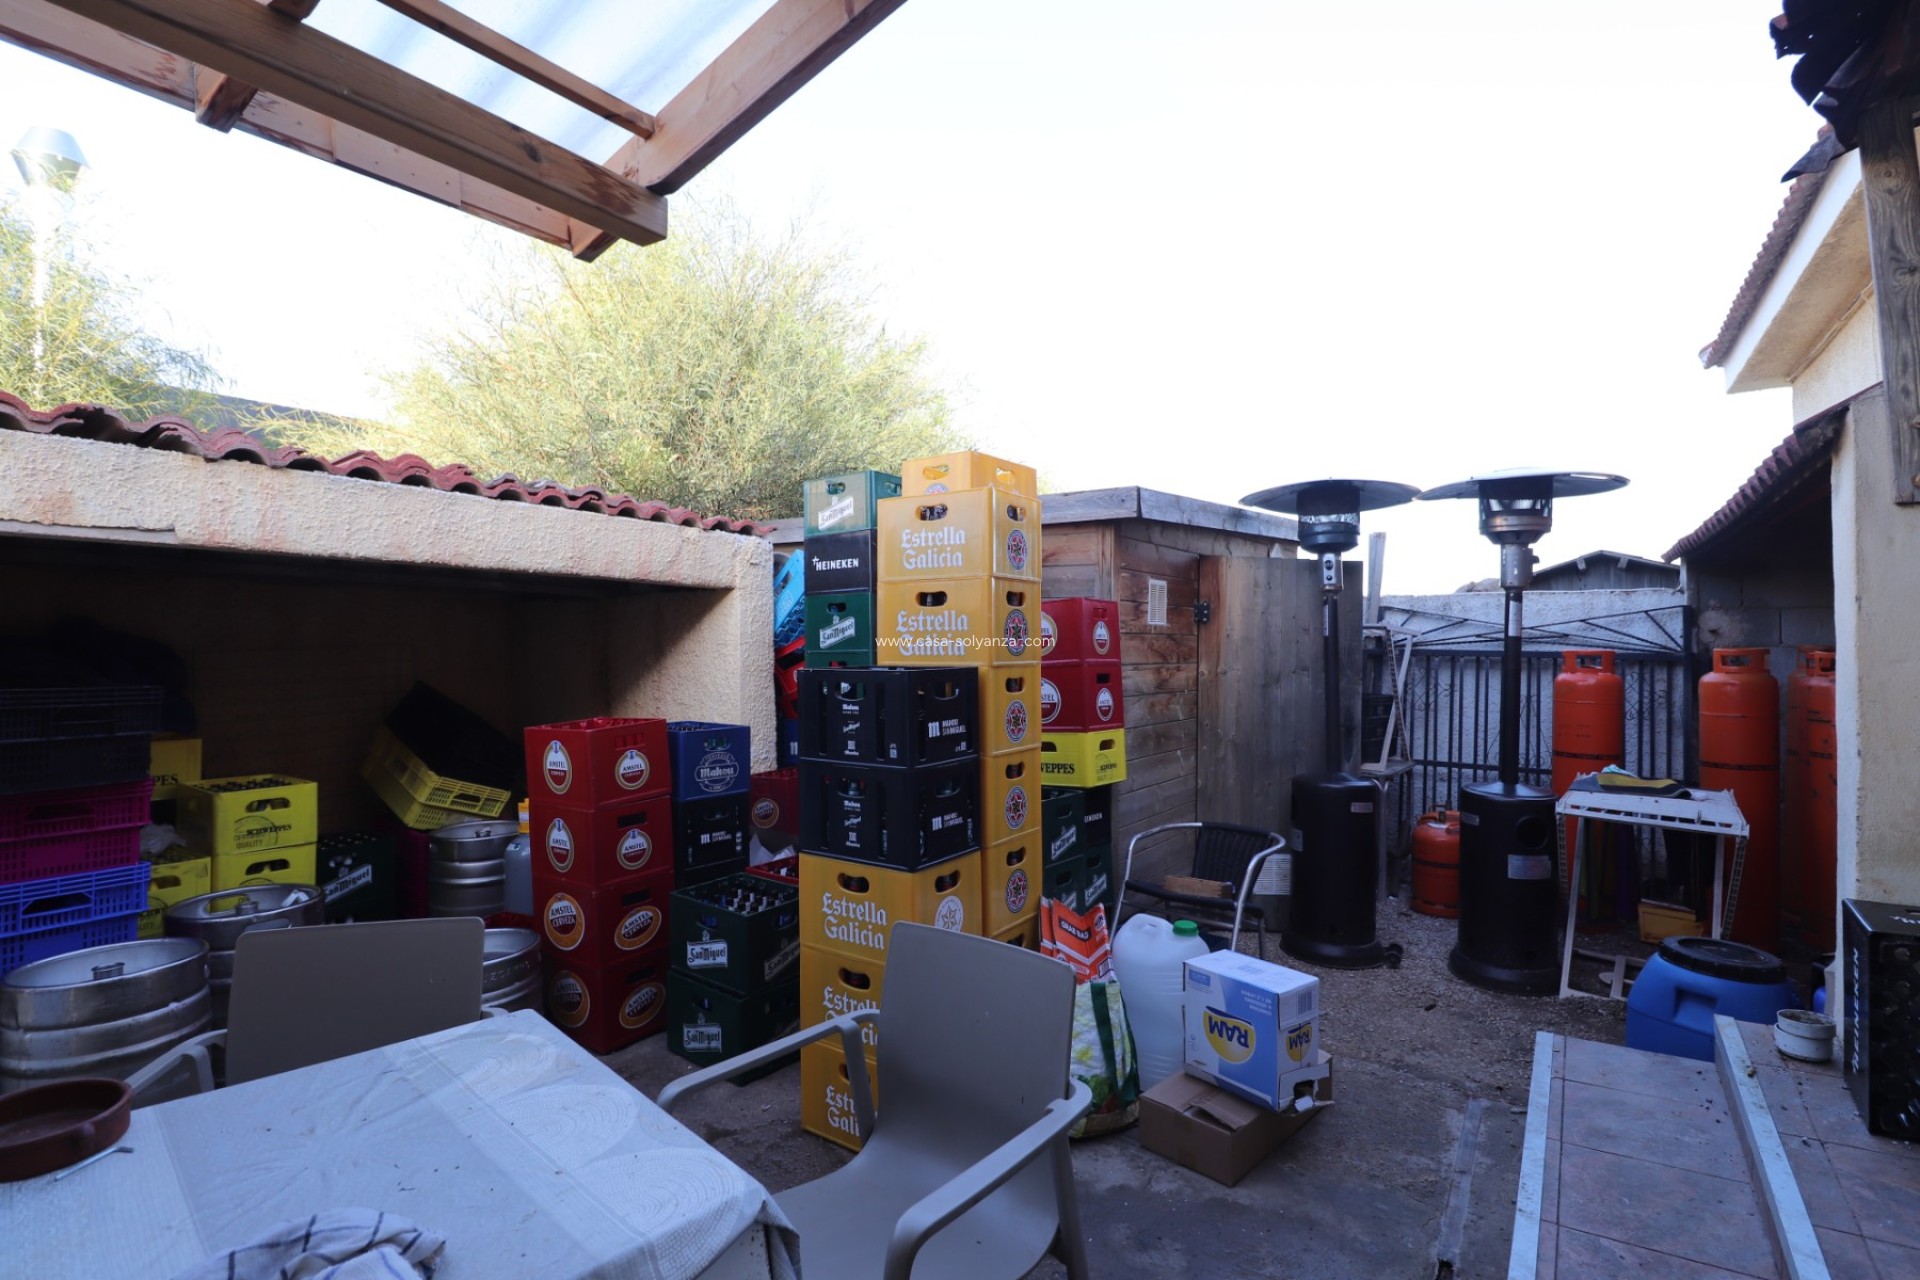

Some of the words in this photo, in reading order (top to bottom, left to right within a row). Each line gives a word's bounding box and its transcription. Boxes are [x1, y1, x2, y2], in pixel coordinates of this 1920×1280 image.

[901, 526, 966, 549] Estrella
[815, 558, 859, 571] HEINEKEN
[903, 547, 963, 570] Galicia
[896, 608, 969, 632] Estrella
[899, 633, 966, 656] Galicia
[623, 763, 643, 772] AMSTEL
[700, 766, 734, 778] Mahou
[247, 824, 292, 835] SCHWEPPES
[624, 842, 645, 852] AMSTEL
[551, 905, 575, 917] AMSTEL
[822, 891, 887, 926] Estrella
[552, 915, 576, 928] CERVEZA
[623, 911, 650, 931] AMSTEL
[624, 918, 653, 938] CERVEZA
[824, 915, 885, 950] Galicia
[627, 987, 653, 1009] AMSTEL
[1208, 1015, 1250, 1049] RAM
[1290, 1029, 1310, 1050] RAM
